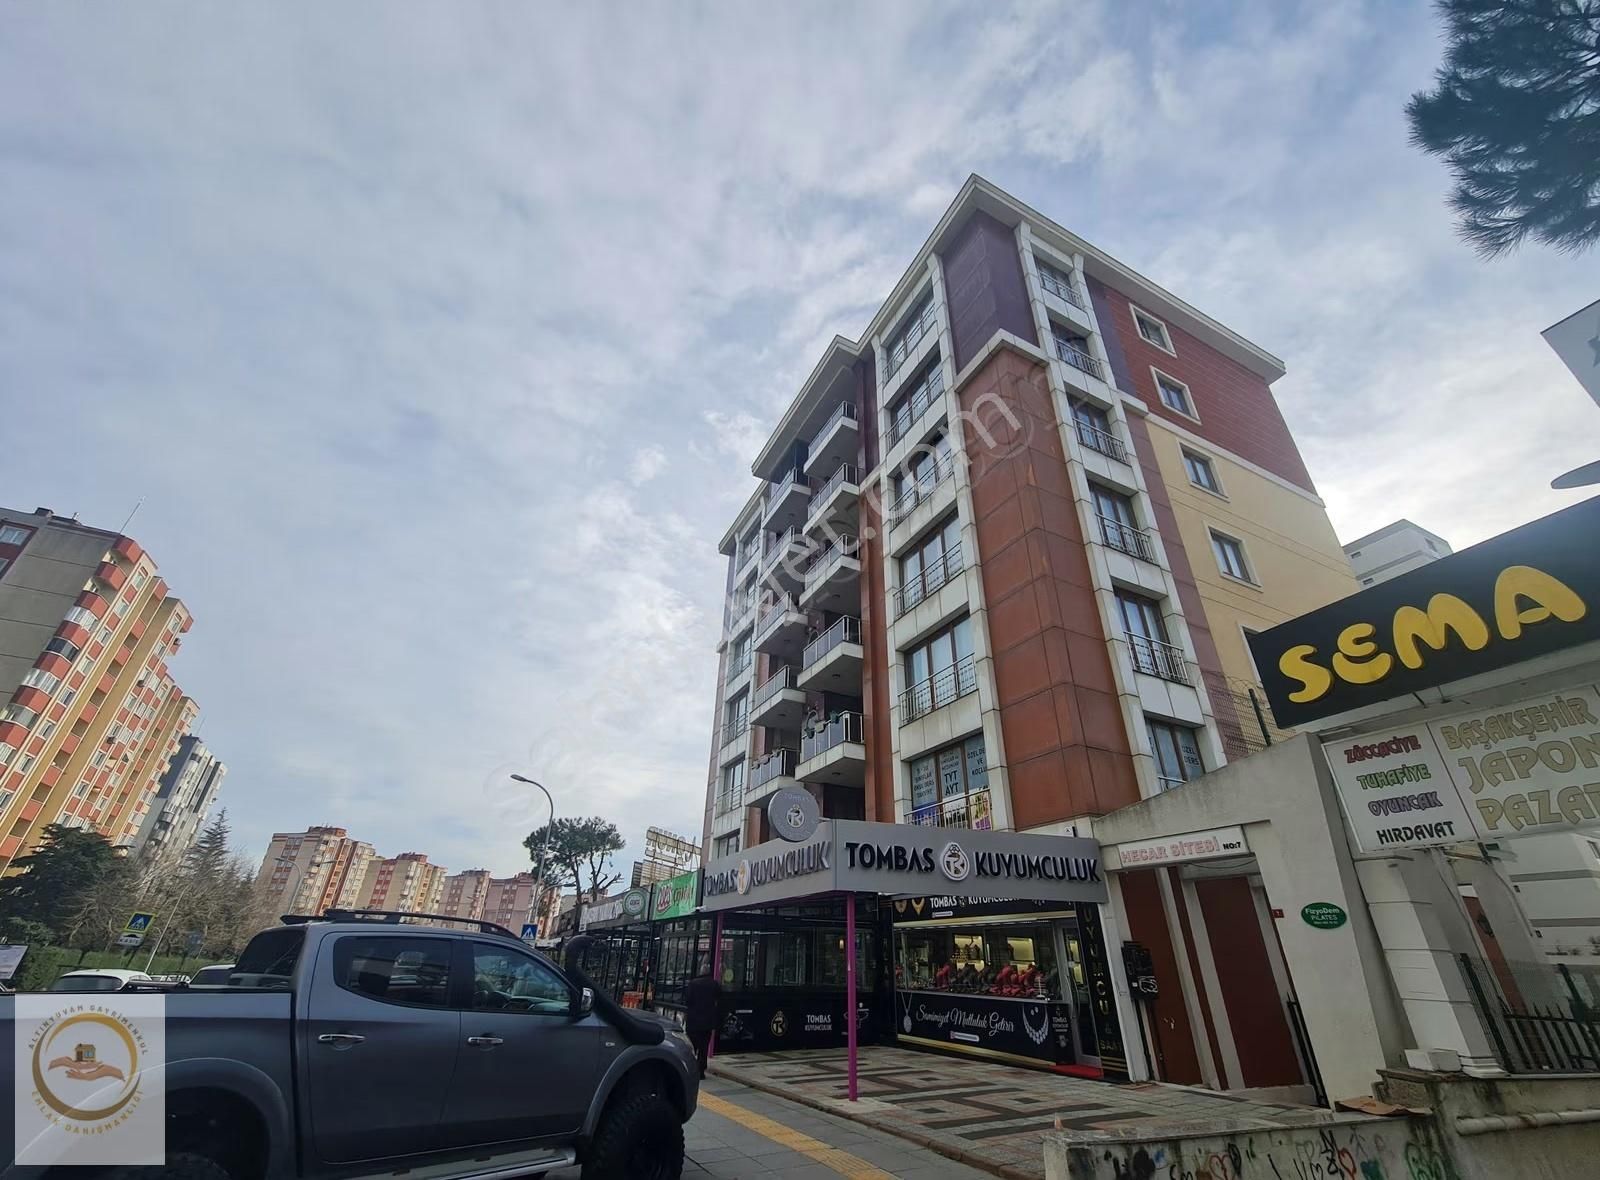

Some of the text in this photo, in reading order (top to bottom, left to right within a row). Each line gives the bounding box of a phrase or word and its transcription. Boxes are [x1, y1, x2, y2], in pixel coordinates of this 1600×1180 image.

[1278, 565, 1588, 705] SEMA
[1440, 696, 1599, 750] BAŞAKŞEHİR
[944, 770, 957, 784] TYT
[1357, 763, 1432, 790] TUHAFİYE
[1458, 732, 1600, 795] JAPON
[945, 782, 958, 796] AYT
[1368, 791, 1444, 817] OYUNCAK
[1376, 821, 1456, 845] HIRDAVAT
[845, 842, 936, 873] TOMBAS
[974, 850, 1102, 883] KUYUMCULUK
[1120, 836, 1242, 864] HECAR SİTESİ NO:7
[704, 868, 739, 897] TOMBAS
[750, 841, 831, 887] KUYUMCULUK
[929, 895, 957, 909] TOMBAS
[806, 1014, 832, 1023] TOMBAS
[950, 1007, 988, 1029] Mutluluk
[988, 1011, 1015, 1037] Getirir
